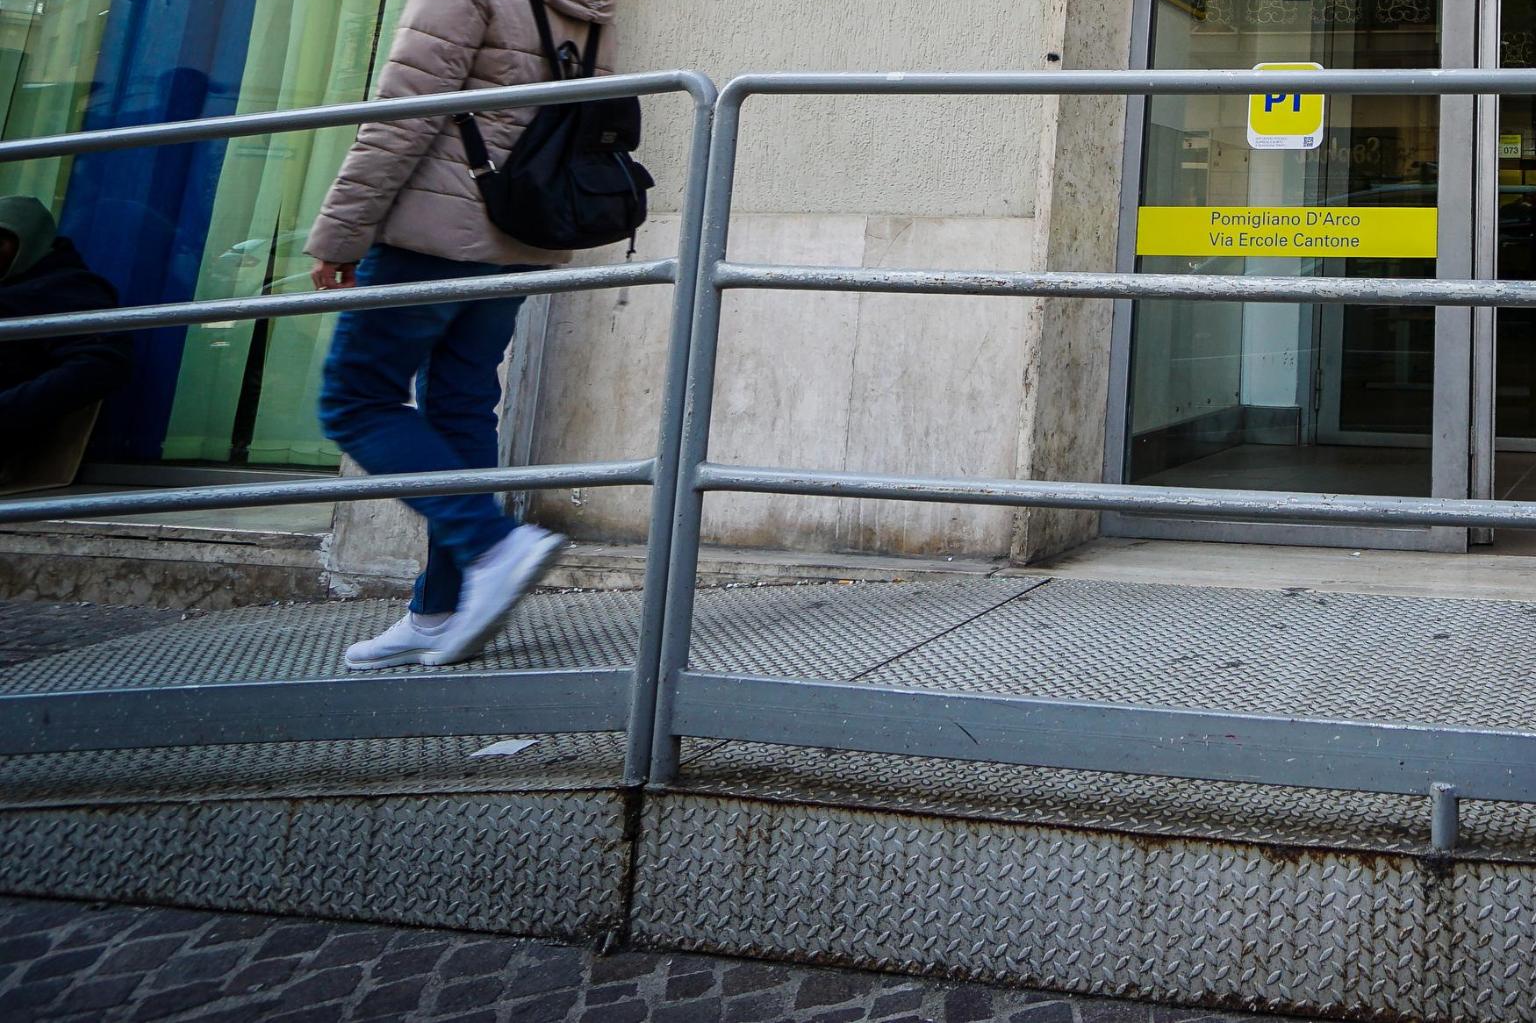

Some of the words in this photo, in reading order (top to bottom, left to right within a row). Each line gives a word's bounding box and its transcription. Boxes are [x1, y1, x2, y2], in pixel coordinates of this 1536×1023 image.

[1211, 211, 1301, 228] Pomigliano
[1306, 211, 1361, 226] D'Arco
[1209, 232, 1233, 247] Via
[1239, 232, 1288, 247] Ercole
[1293, 233, 1360, 247] Cantone
